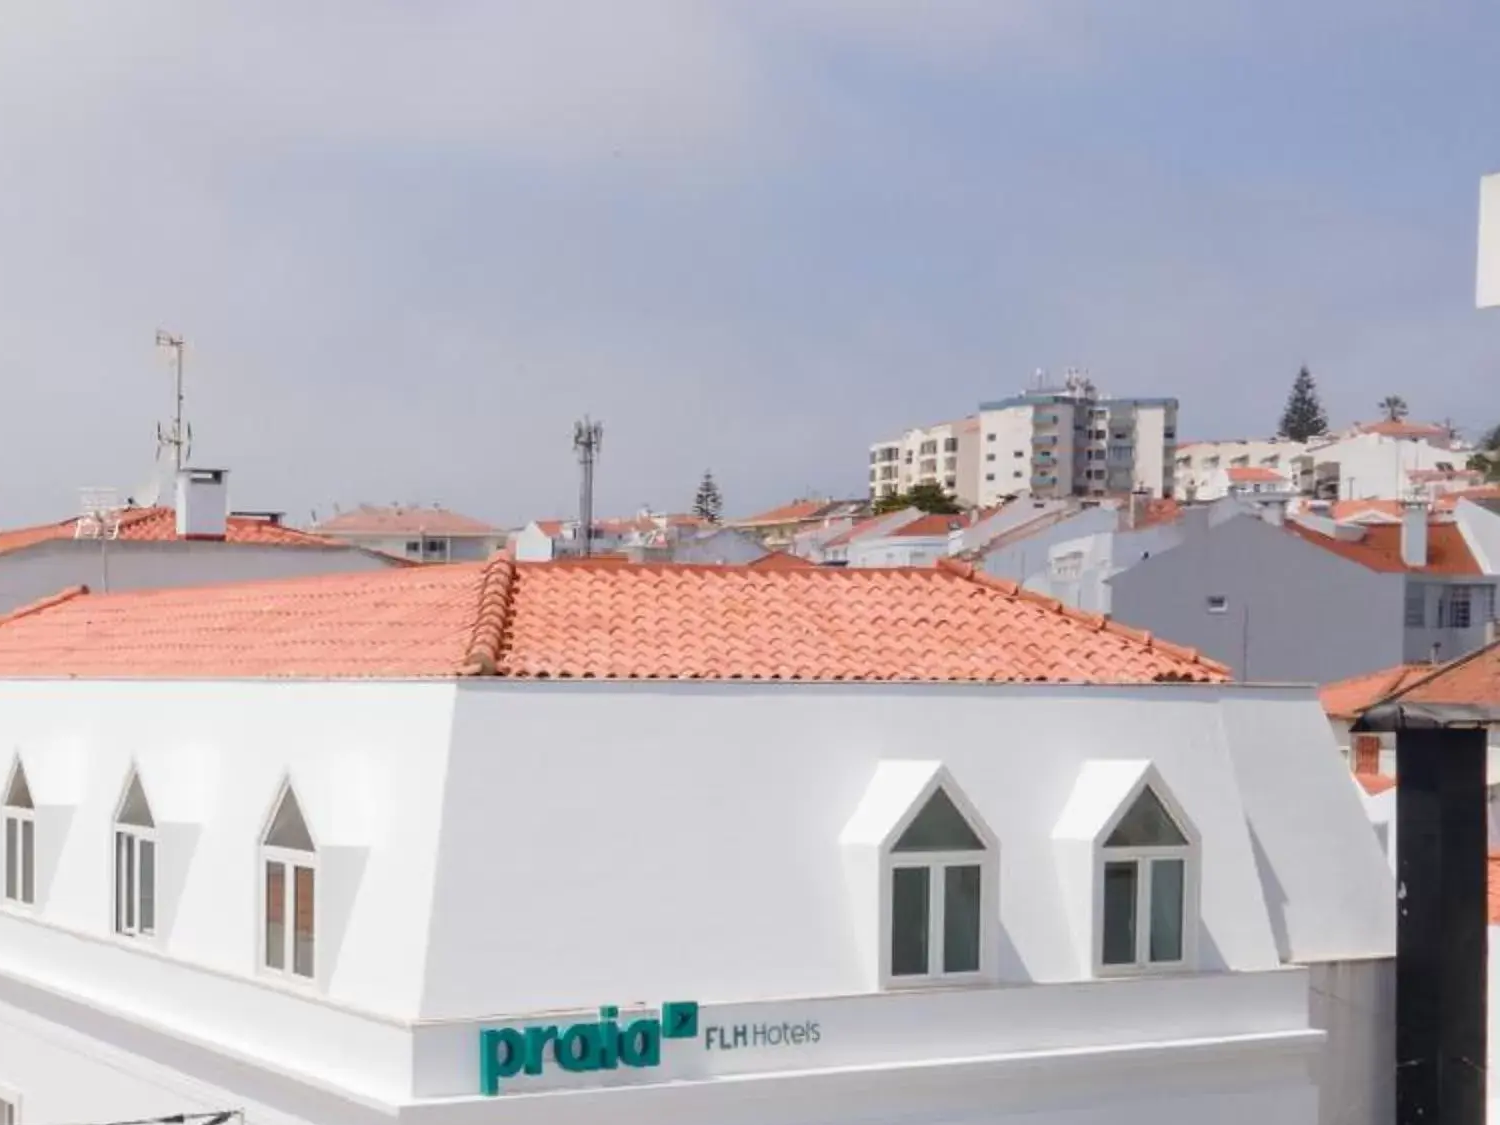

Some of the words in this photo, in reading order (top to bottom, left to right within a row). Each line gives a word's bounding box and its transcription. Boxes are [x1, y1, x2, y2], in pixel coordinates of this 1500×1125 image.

[480, 1005, 660, 1096] praia
[705, 1024, 748, 1050] FLH
[752, 1020, 822, 1046] Hotels
